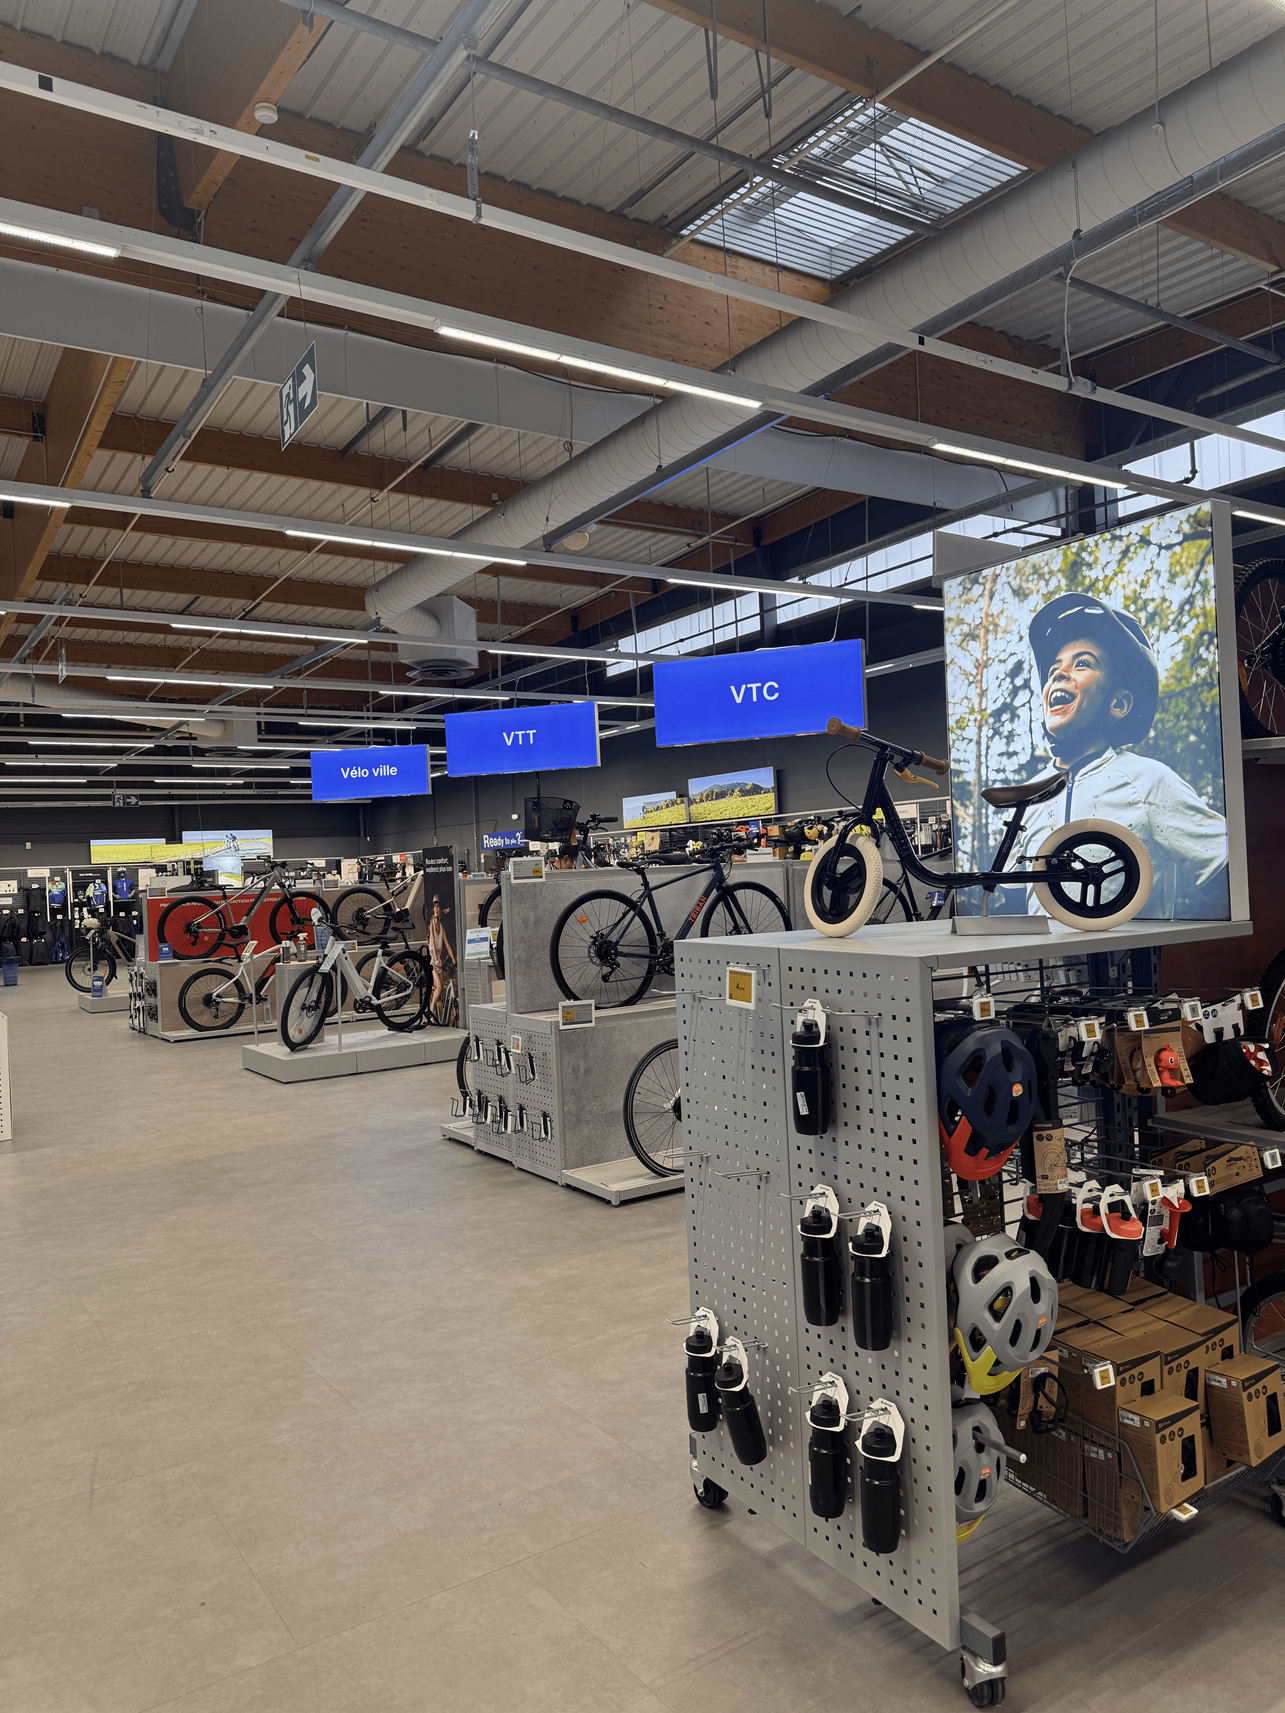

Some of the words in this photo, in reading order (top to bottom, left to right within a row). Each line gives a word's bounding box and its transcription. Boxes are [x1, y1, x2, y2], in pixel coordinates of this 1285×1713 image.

[730, 681, 779, 704] VTC
[502, 729, 537, 746] VTT
[340, 765, 369, 779] Vélo
[371, 764, 398, 777] ville
[483, 834, 504, 848] Ready
[504, 836, 510, 845] to
[688, 895, 707, 923] TRIBAN
